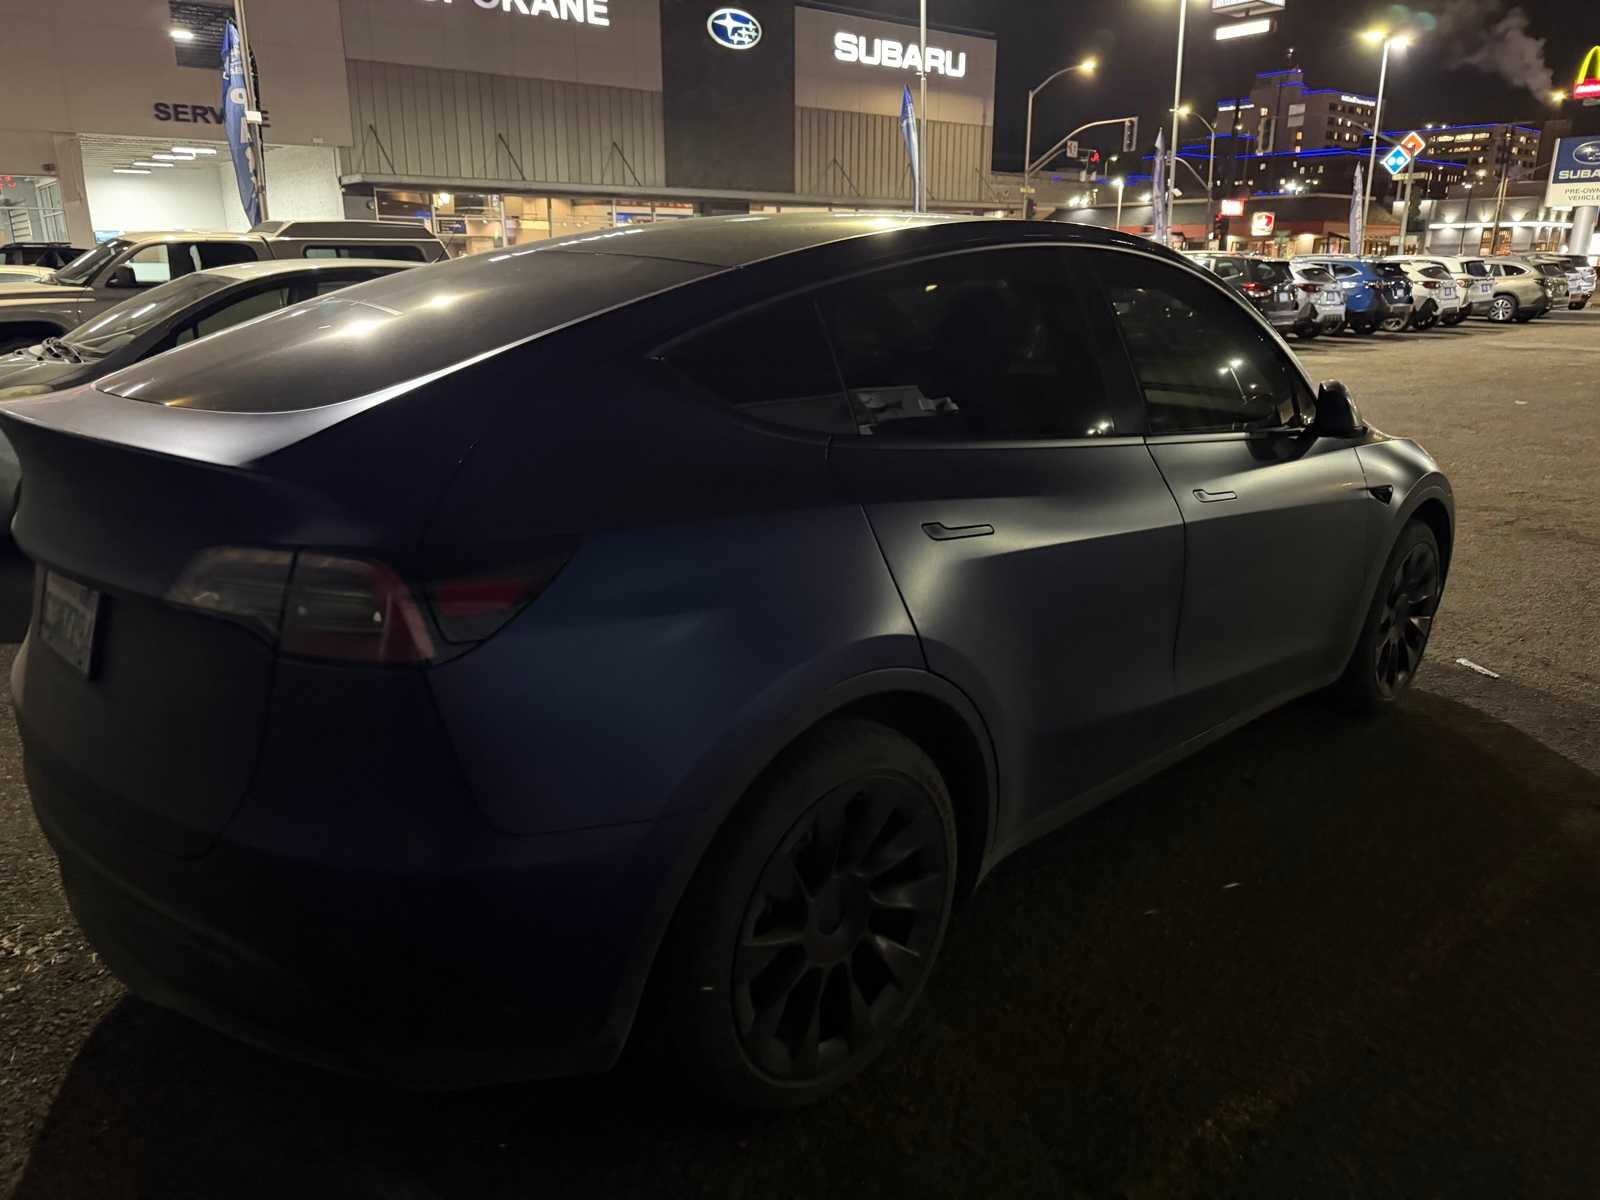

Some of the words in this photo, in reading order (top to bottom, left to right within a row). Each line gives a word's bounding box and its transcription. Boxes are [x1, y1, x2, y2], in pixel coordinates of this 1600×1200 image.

[421, 0, 609, 26] KANE
[834, 31, 966, 78] SUBARU
[154, 102, 271, 128] SERVE
